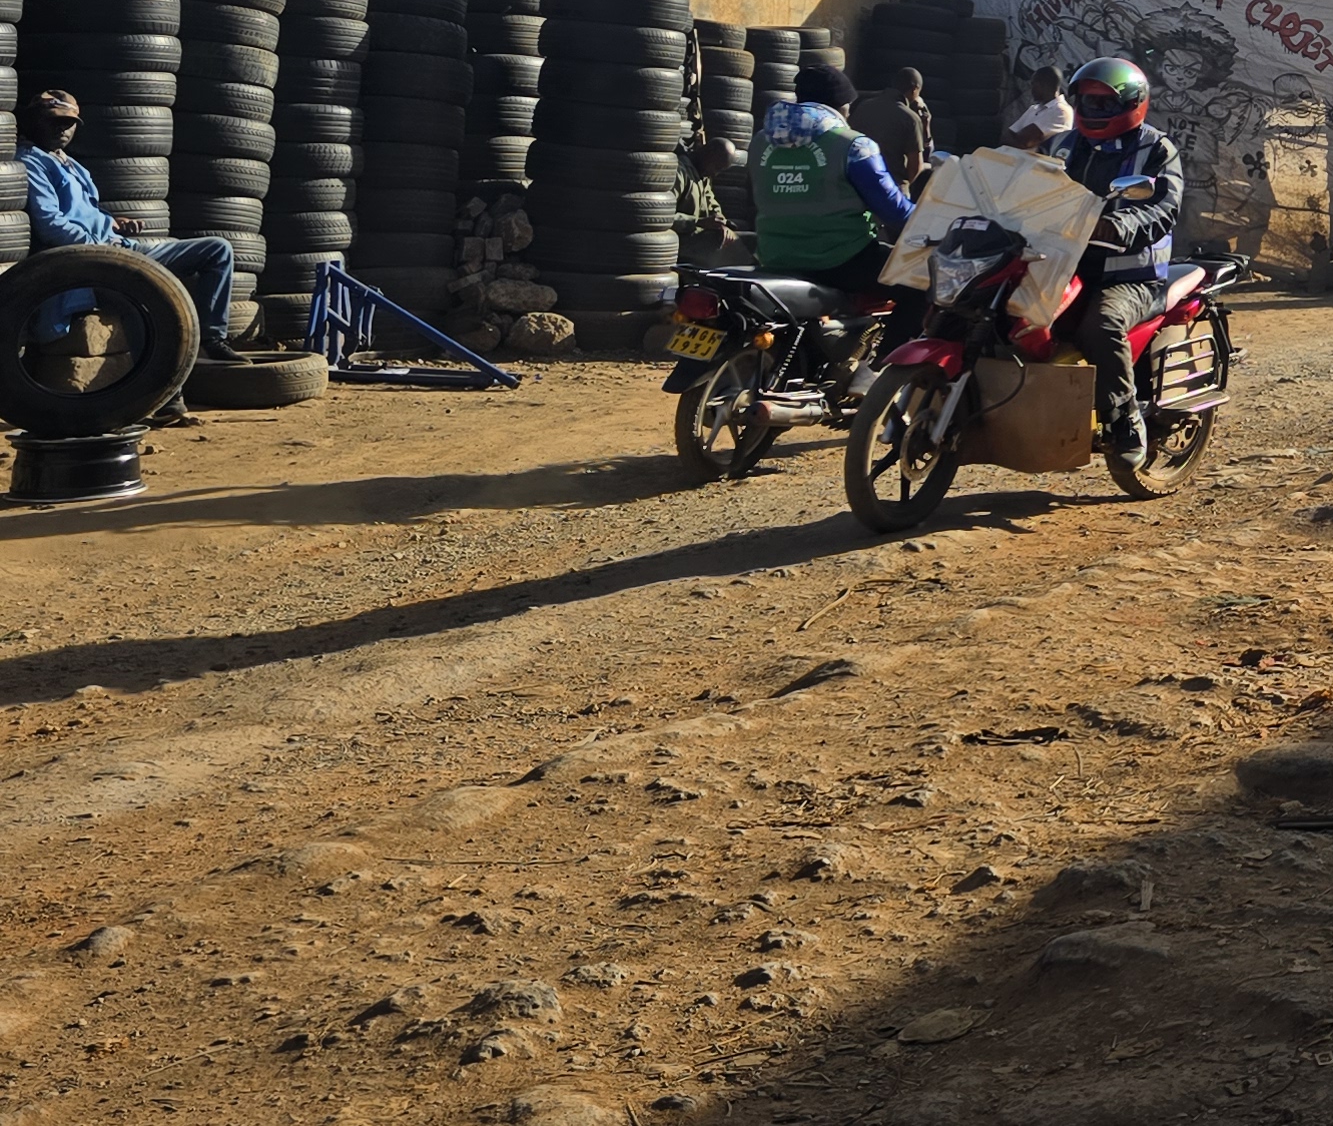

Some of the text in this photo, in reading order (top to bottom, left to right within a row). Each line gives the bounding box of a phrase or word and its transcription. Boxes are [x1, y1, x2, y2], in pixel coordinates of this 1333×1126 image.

[1168, 117, 1200, 133] NOT
[777, 173, 804, 184] 024
[773, 185, 809, 193] UTHIRU
